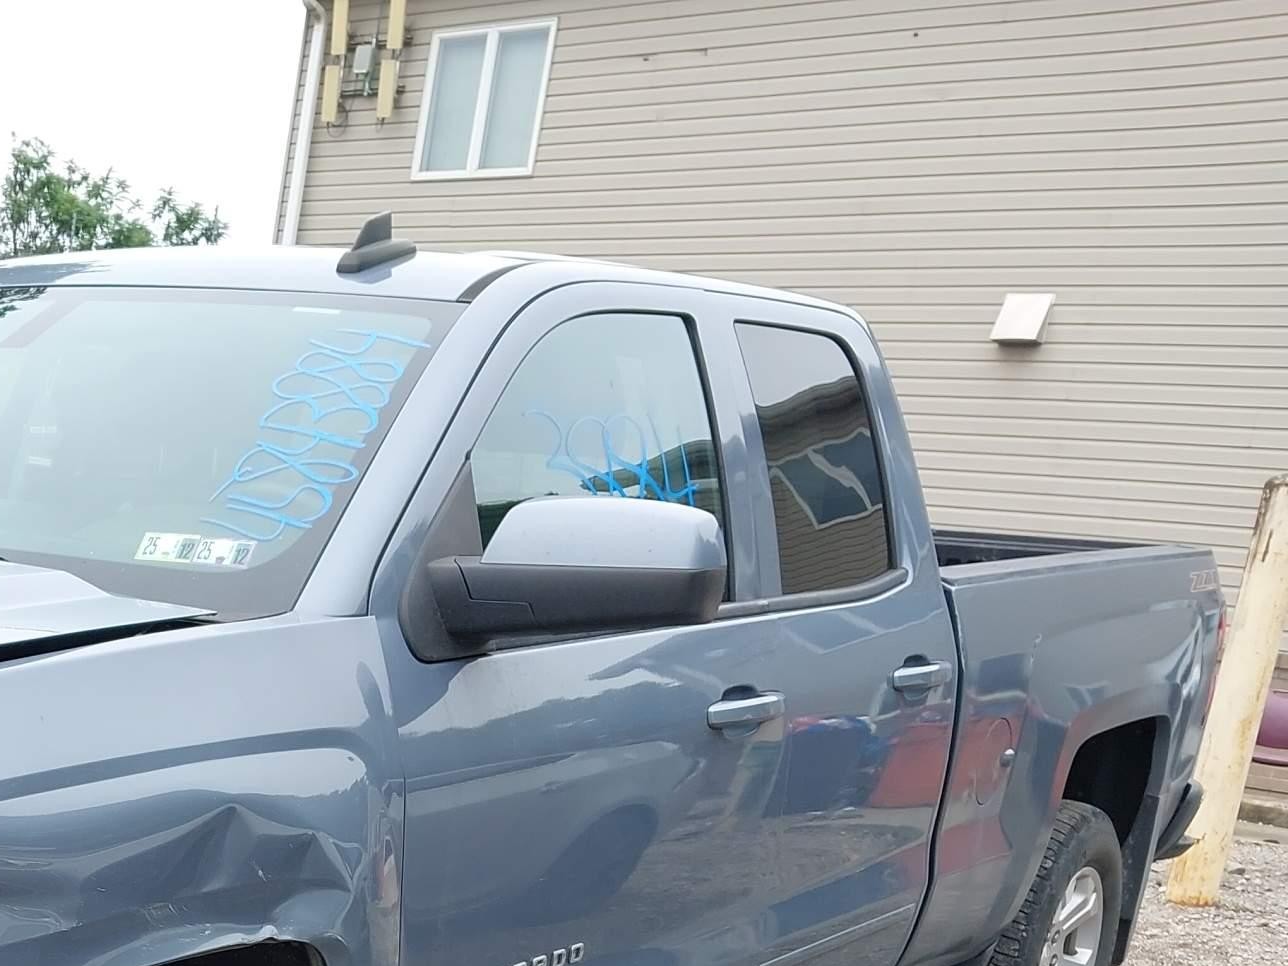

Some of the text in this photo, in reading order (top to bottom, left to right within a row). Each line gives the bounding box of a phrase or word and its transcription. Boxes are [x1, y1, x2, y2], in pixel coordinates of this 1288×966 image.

[143, 537, 194, 559] 25 12
[198, 541, 250, 565] 25 12
